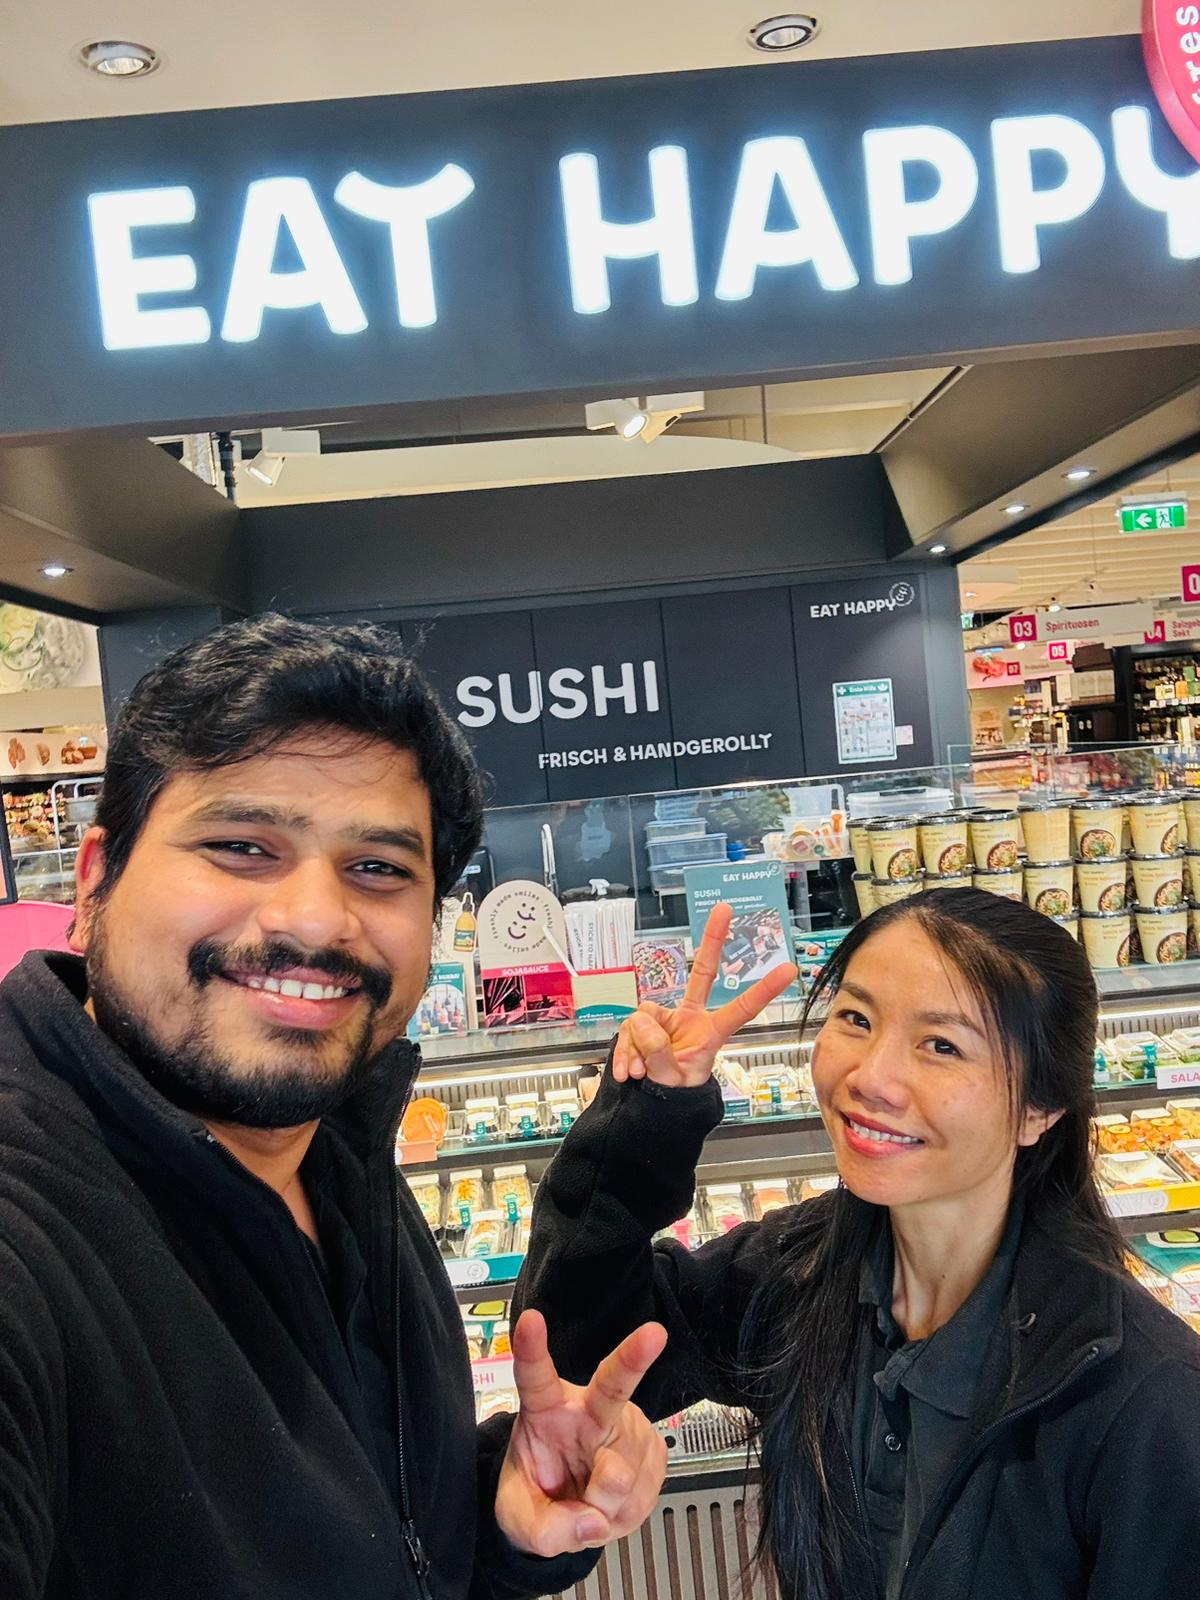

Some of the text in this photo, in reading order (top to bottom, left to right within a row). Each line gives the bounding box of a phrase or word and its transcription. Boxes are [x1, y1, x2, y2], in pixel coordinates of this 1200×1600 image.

[87, 105, 1200, 351] EAT HAPPY
[810, 598, 897, 619] EAT HAPPY
[1013, 618, 1100, 638] 03 Spirituosen
[1051, 645, 1065, 658] 05
[456, 660, 660, 728] SUSHI
[538, 748, 608, 770] FRISCH
[613, 746, 628, 762] &
[723, 870, 772, 882] EAT HAPPY
[694, 889, 721, 898] SUSHI
[502, 965, 550, 976] SOJASAUCE
[1170, 1071, 1200, 1084] SALA
